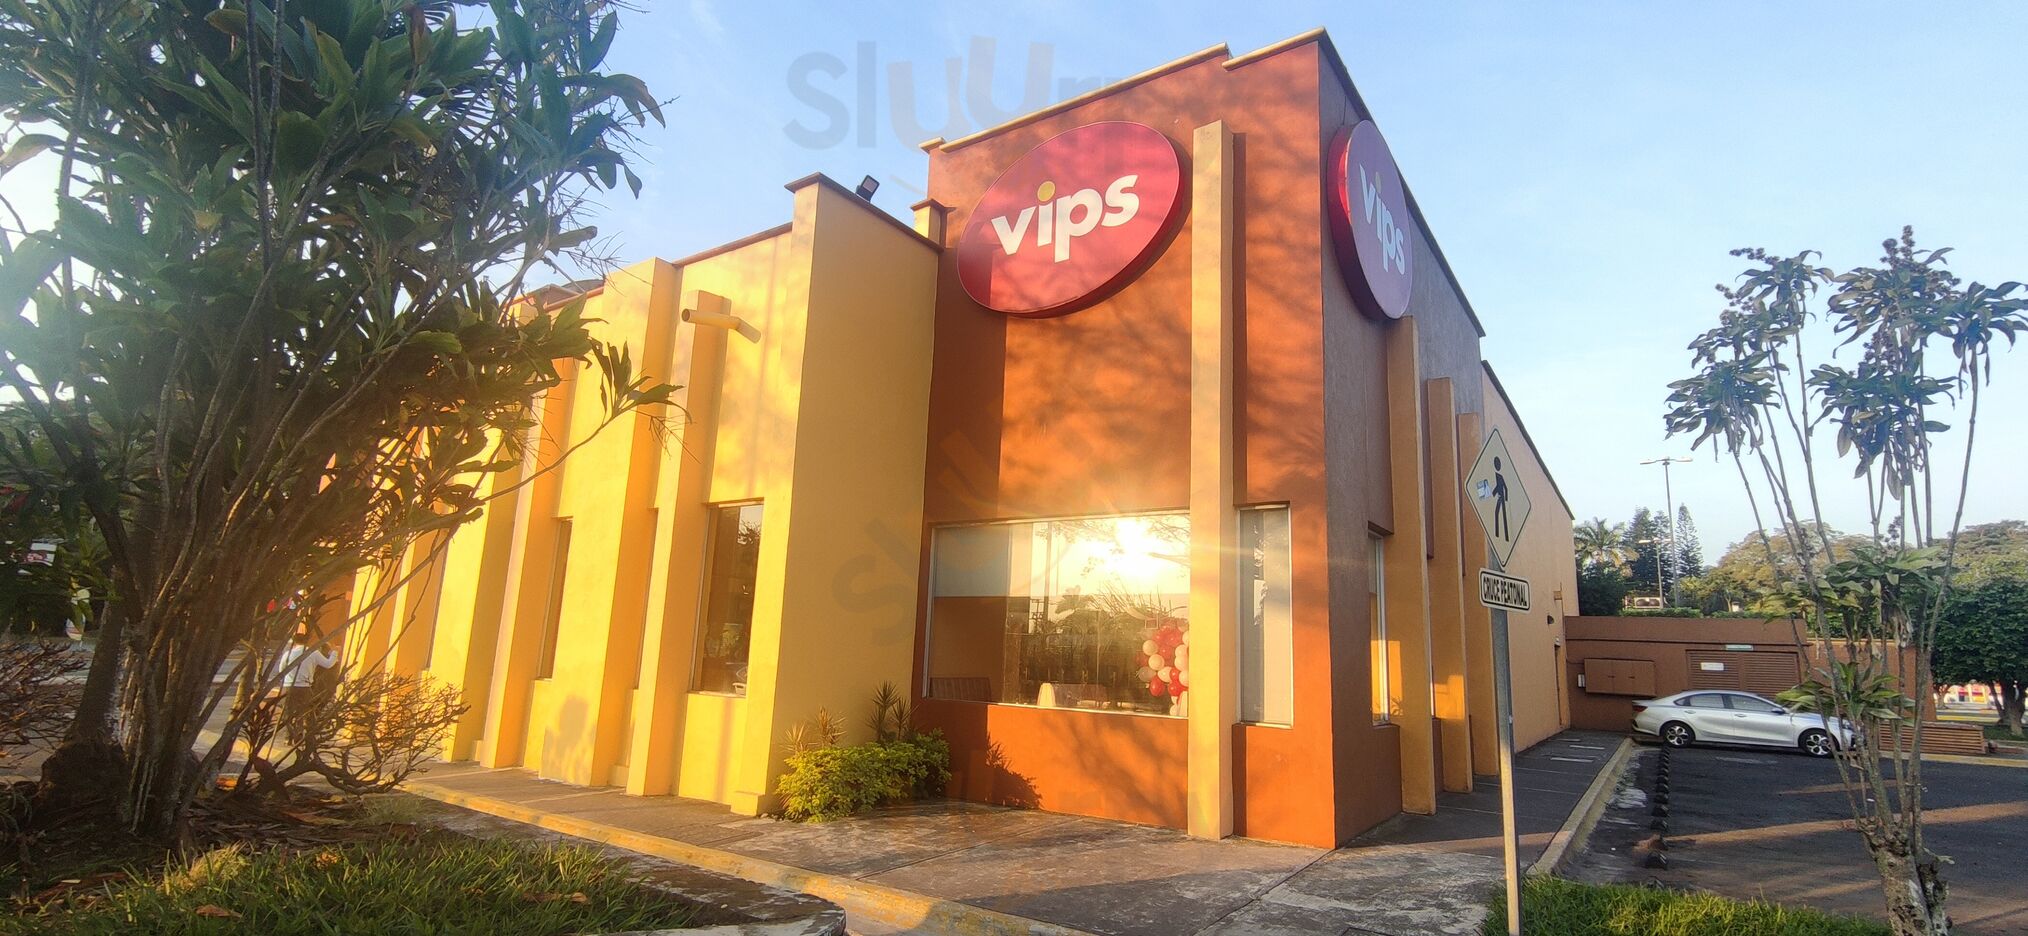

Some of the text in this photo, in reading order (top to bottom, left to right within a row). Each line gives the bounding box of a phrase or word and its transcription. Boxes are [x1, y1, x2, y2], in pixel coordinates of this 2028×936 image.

[991, 174, 1140, 263] vips
[1360, 163, 1405, 275] vips
[1483, 575, 1527, 607] CRUCE PEATONAL
